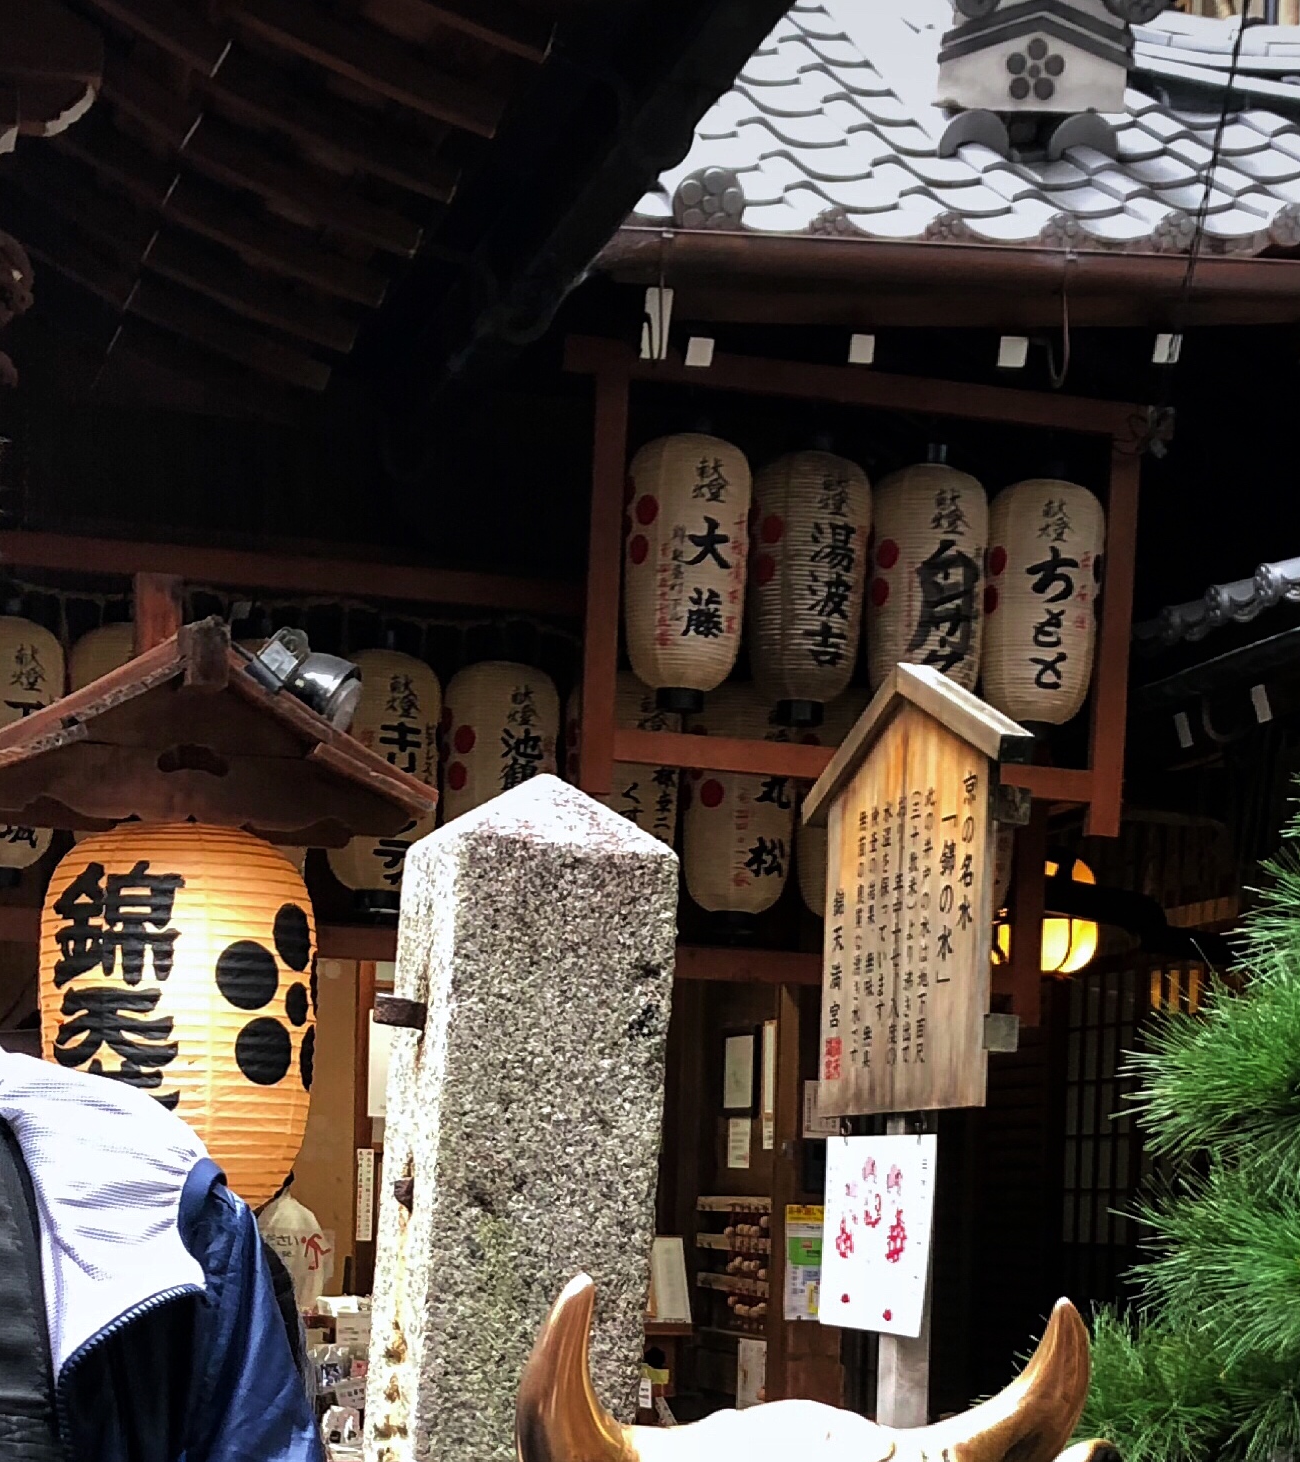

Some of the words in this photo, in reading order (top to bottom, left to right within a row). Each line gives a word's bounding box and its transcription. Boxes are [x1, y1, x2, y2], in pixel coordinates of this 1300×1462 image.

[675, 516, 731, 638] 大藤
[803, 522, 856, 667] 湯波吉
[956, 770, 977, 931] 京の名水
